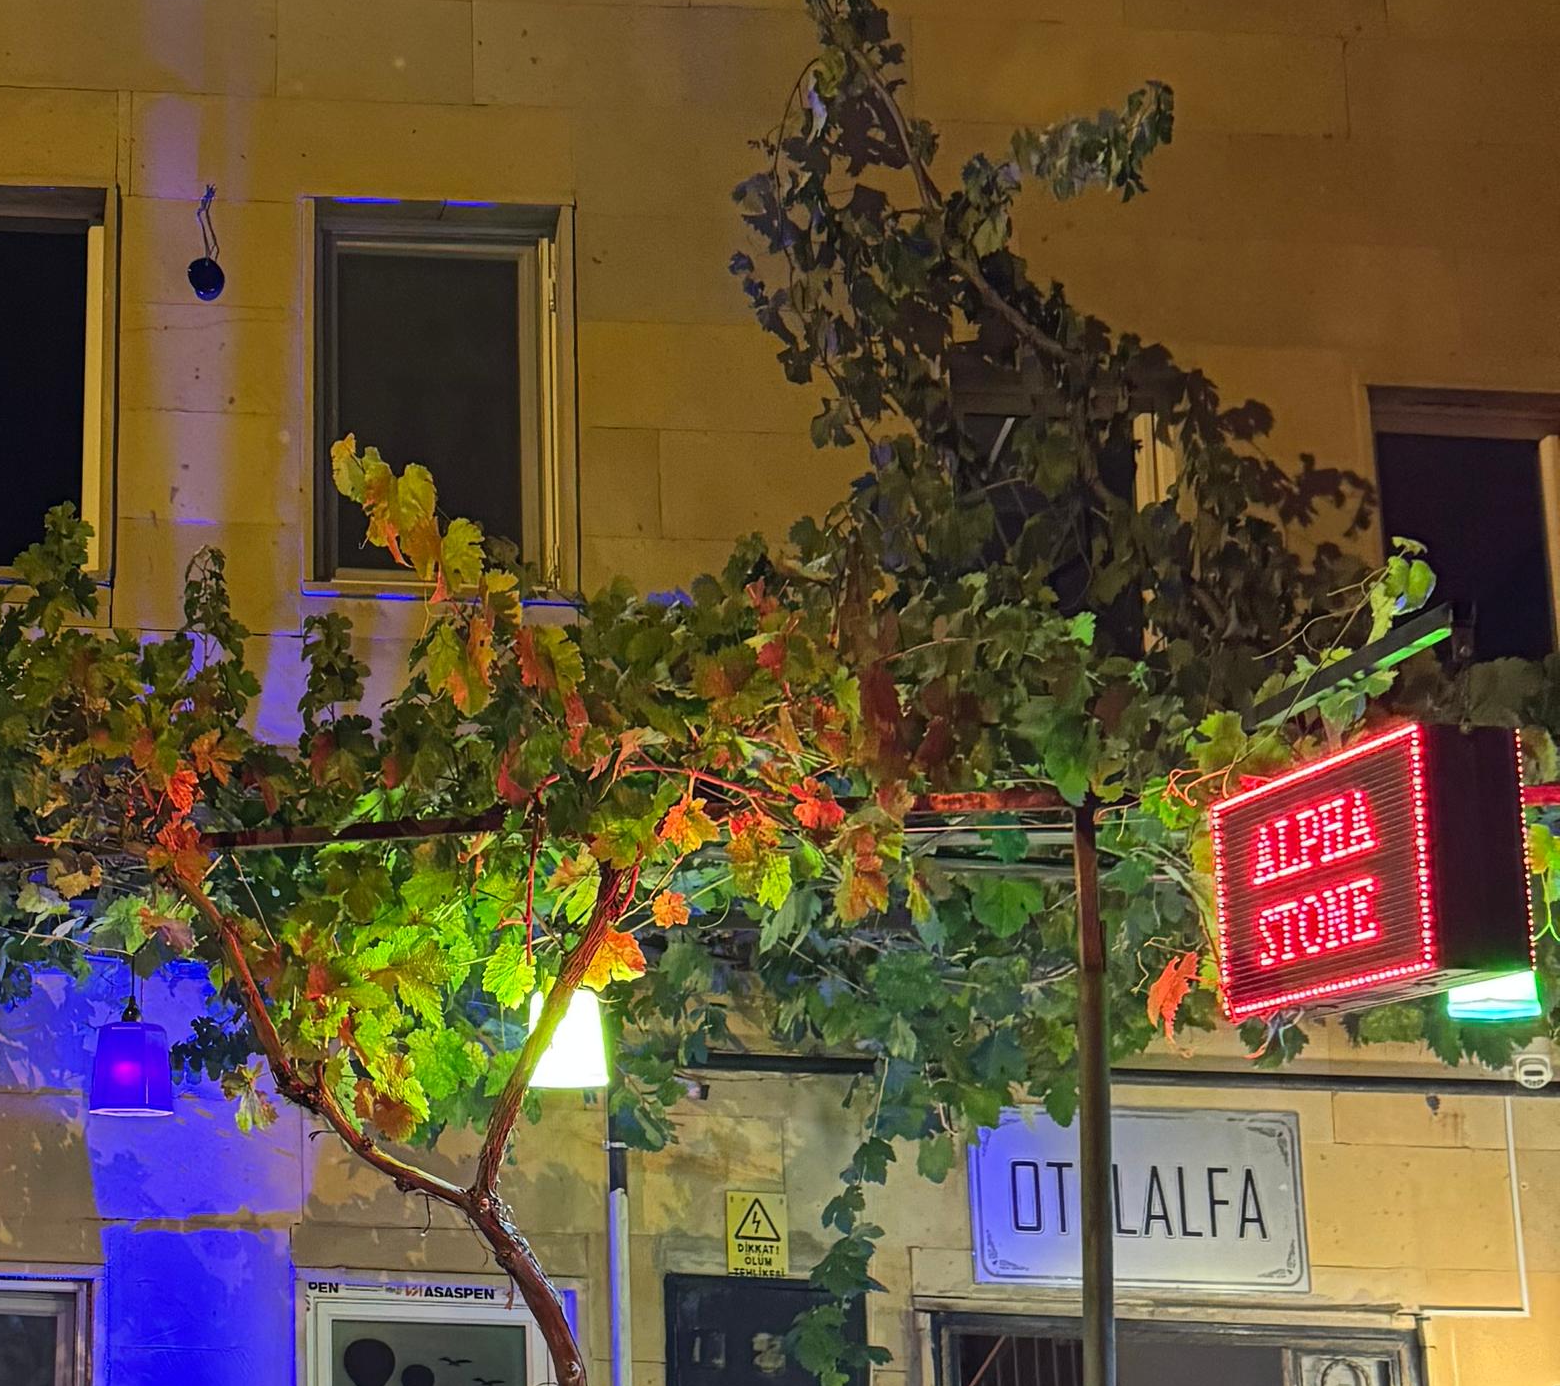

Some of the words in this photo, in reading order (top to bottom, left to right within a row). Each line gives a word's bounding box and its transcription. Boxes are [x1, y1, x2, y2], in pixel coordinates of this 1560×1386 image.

[1252, 790, 1377, 885] ALPHA
[1258, 877, 1378, 966] STONE
[1010, 1160, 1269, 1240] OTLALFA
[424, 1286, 495, 1300] ASASPEN
